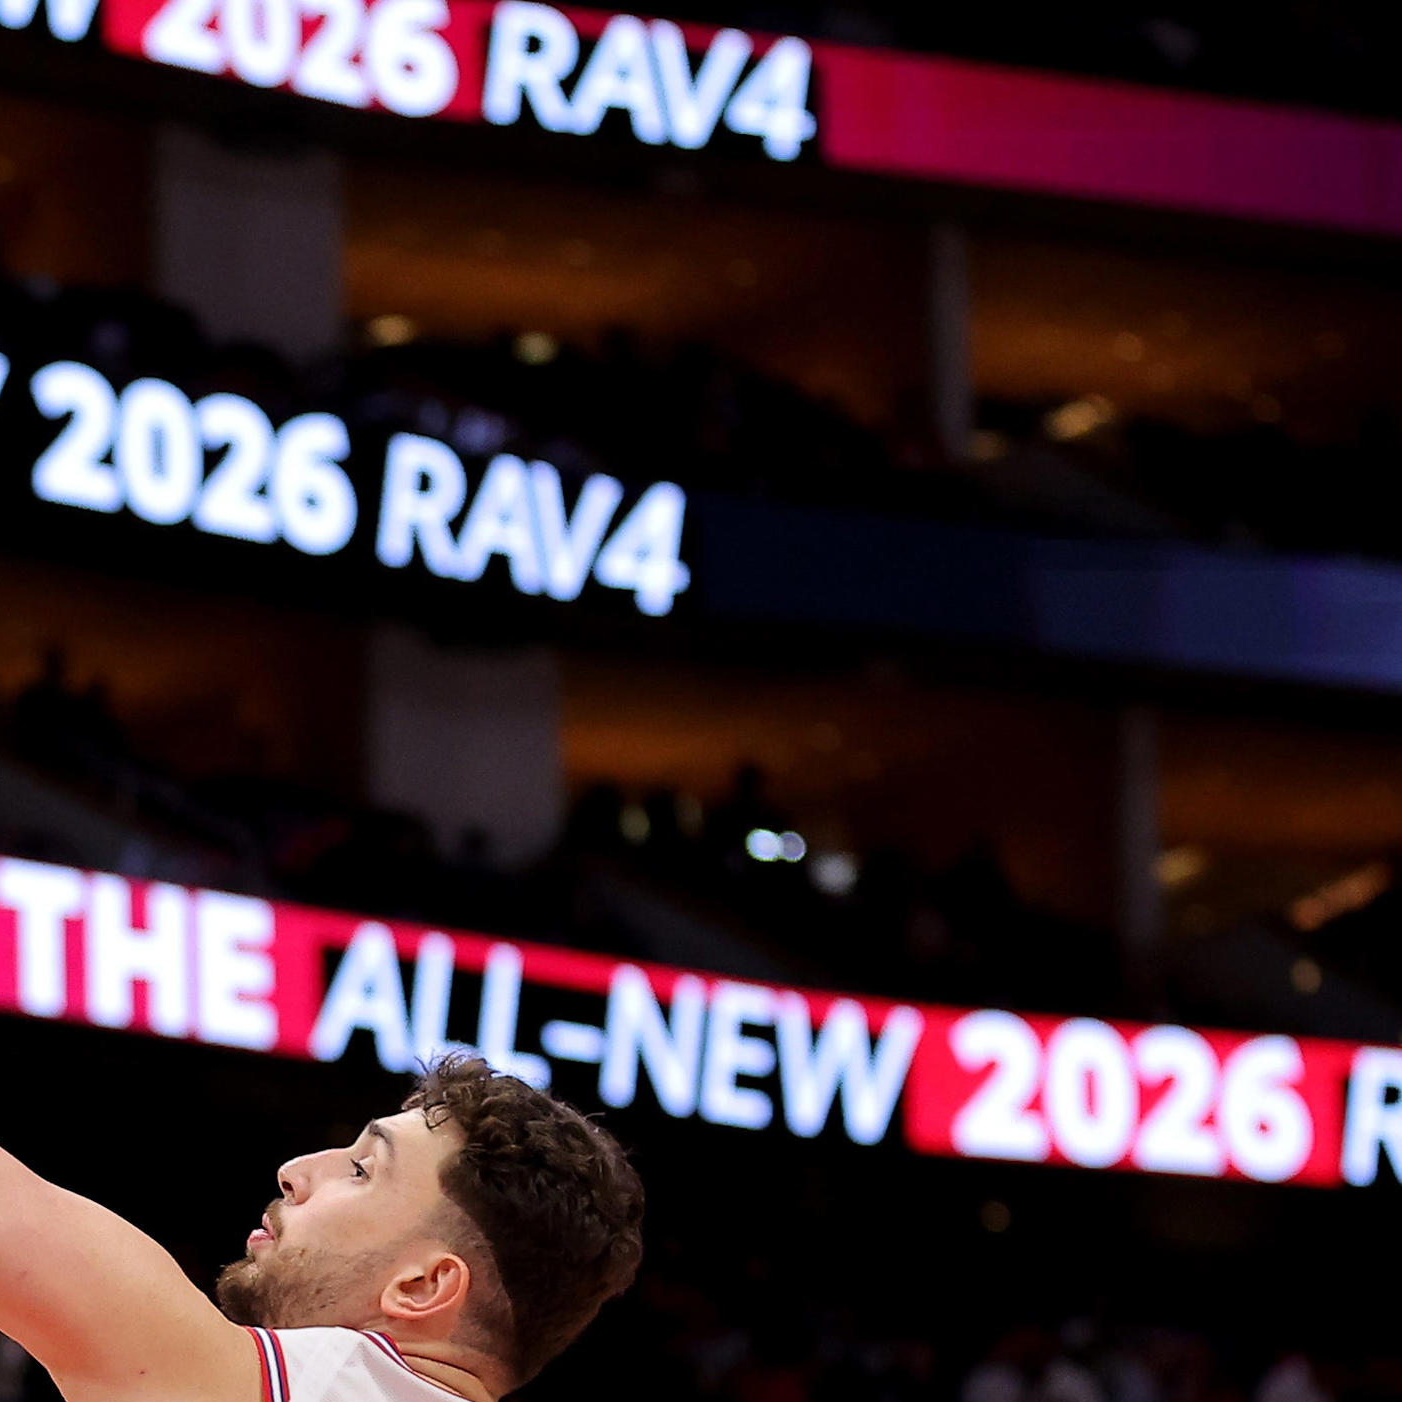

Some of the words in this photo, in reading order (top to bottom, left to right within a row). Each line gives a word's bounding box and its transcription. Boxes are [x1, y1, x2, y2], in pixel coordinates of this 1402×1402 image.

[481, 0, 817, 161] RAV4
[31, 361, 358, 556] 2026
[376, 432, 690, 617] RAV4
[308, 920, 922, 1148] ALL-NEW
[950, 1010, 1314, 1183] 2026
